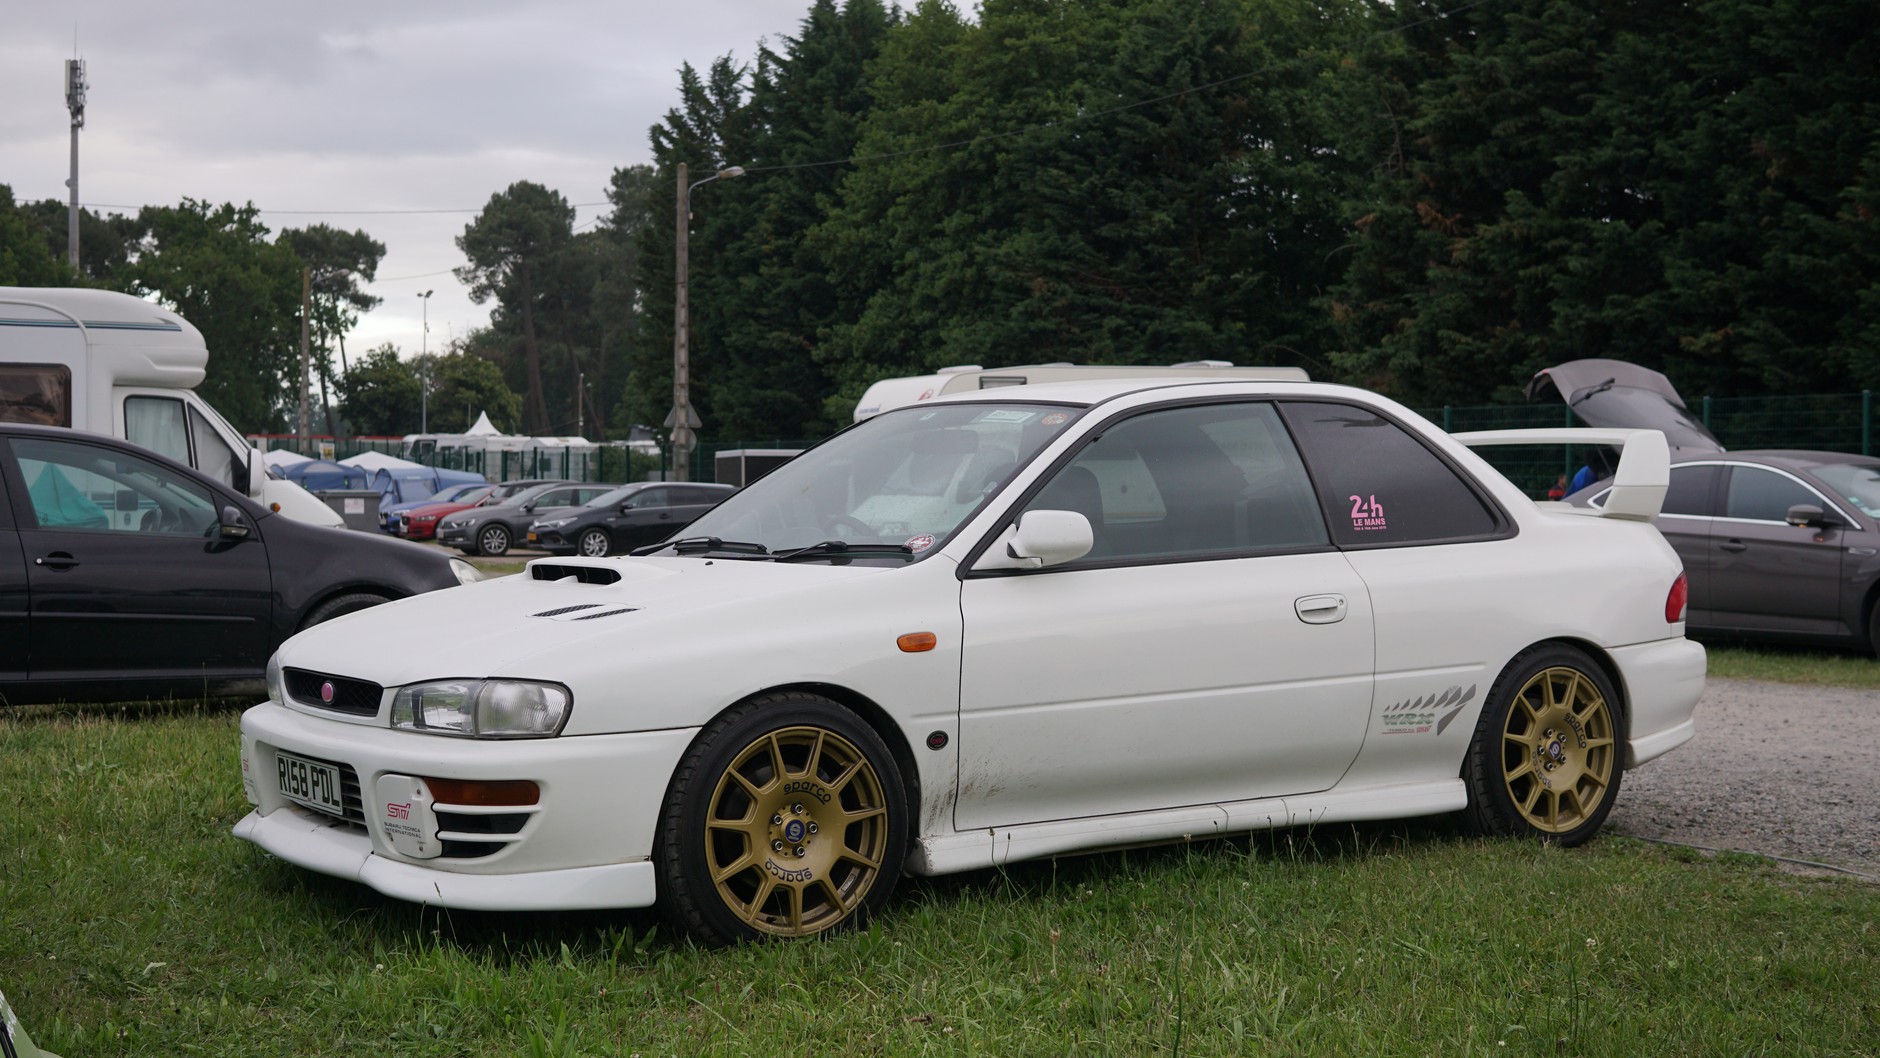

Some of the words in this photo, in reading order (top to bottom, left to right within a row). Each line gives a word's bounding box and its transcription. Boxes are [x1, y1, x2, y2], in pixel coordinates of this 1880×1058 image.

[1349, 494, 1384, 518] 24h
[1364, 518, 1386, 526] MANS
[1382, 713, 1435, 725] WRX
[1564, 713, 1587, 749] sparco
[310, 765, 341, 808] PDL
[783, 781, 832, 803] sparco
[383, 821, 402, 829] SUBARU
[402, 825, 421, 833] TECNICA
[384, 827, 422, 838] INTERNATIONAL
[764, 860, 813, 882] sparco
